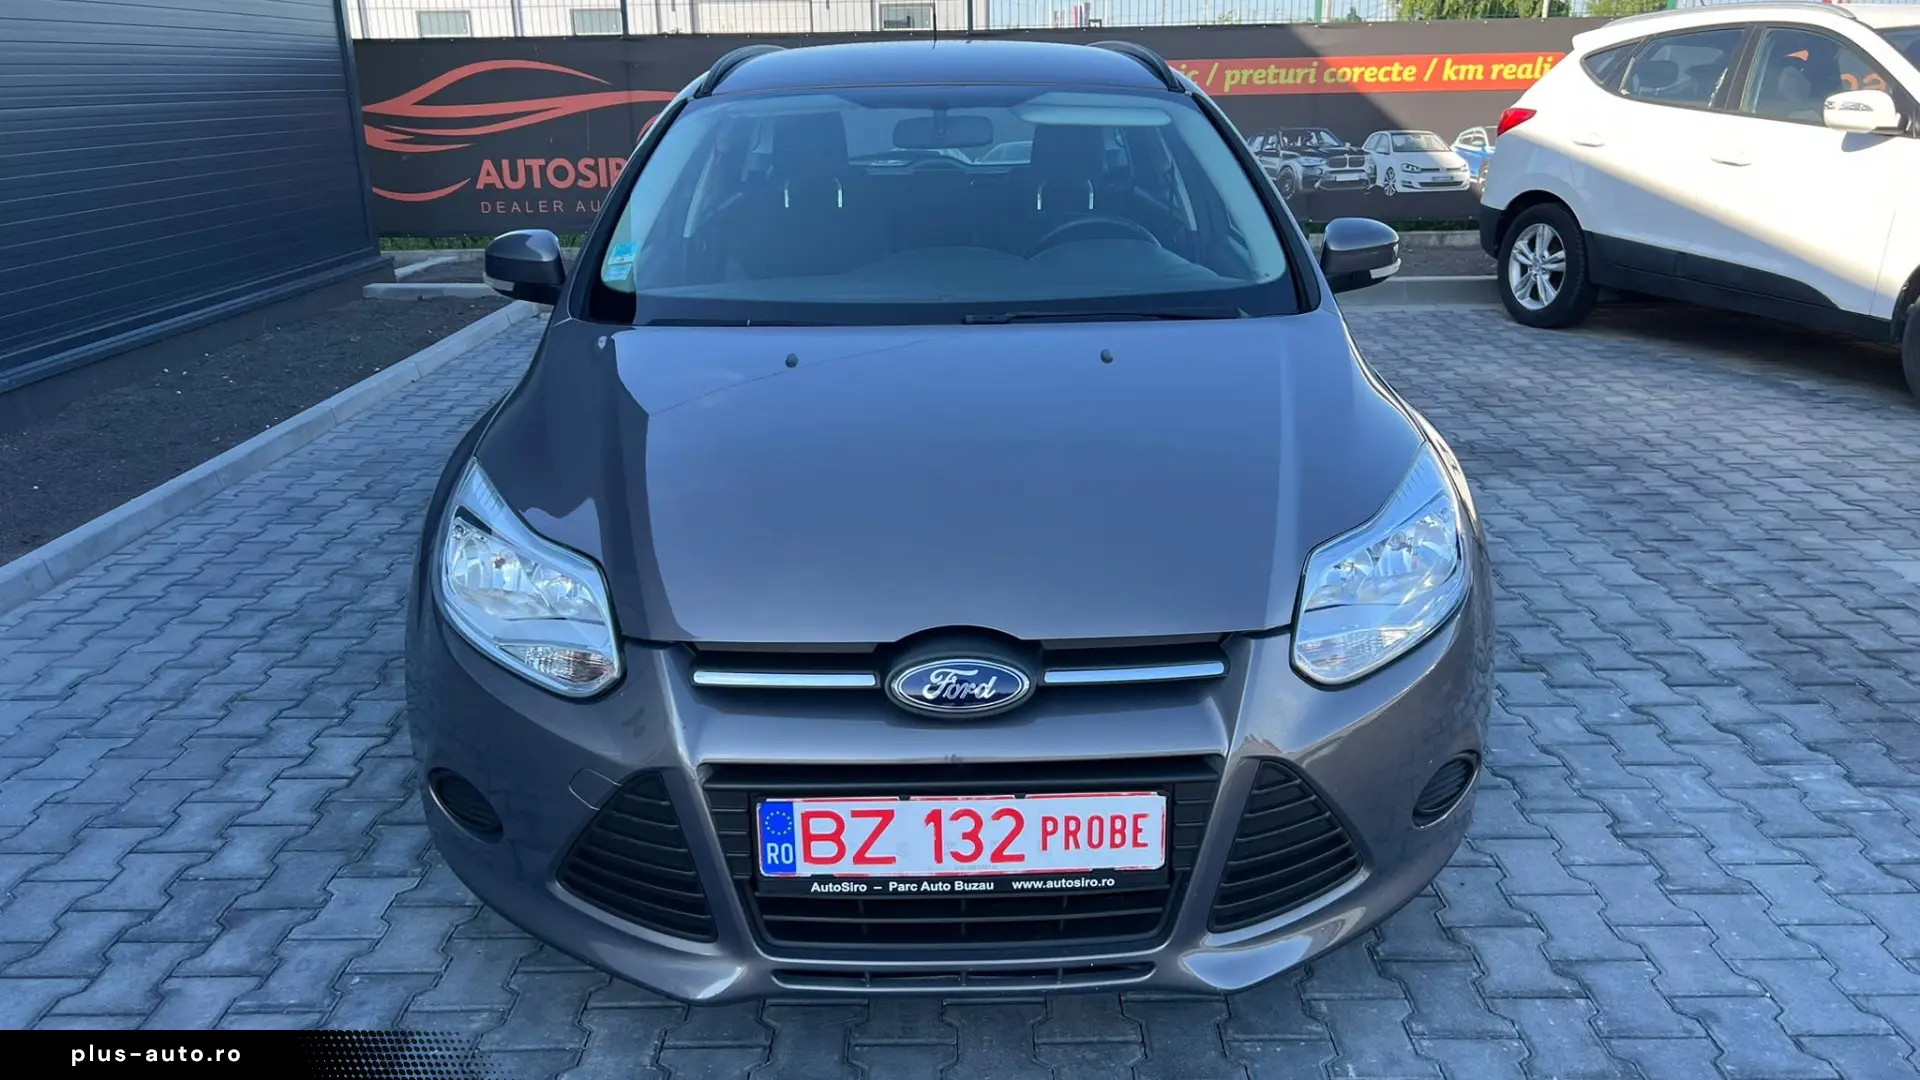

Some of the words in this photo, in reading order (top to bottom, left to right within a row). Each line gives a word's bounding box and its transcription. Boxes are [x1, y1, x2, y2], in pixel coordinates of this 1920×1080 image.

[1223, 61, 1319, 92] preturi
[1323, 60, 1417, 84] corecte
[1442, 58, 1484, 82] km
[481, 200, 564, 213] DEALER
[922, 668, 996, 701] Ford
[801, 808, 897, 865] BZ
[924, 808, 1025, 864] 132
[1041, 813, 1150, 851] PROBE
[767, 843, 794, 865] RO
[811, 882, 867, 892] AutoSiro
[889, 881, 918, 892] Parc
[921, 881, 951, 892] Auto
[954, 880, 995, 891] Buzau
[1012, 877, 1115, 890] www.autosiro.ro
